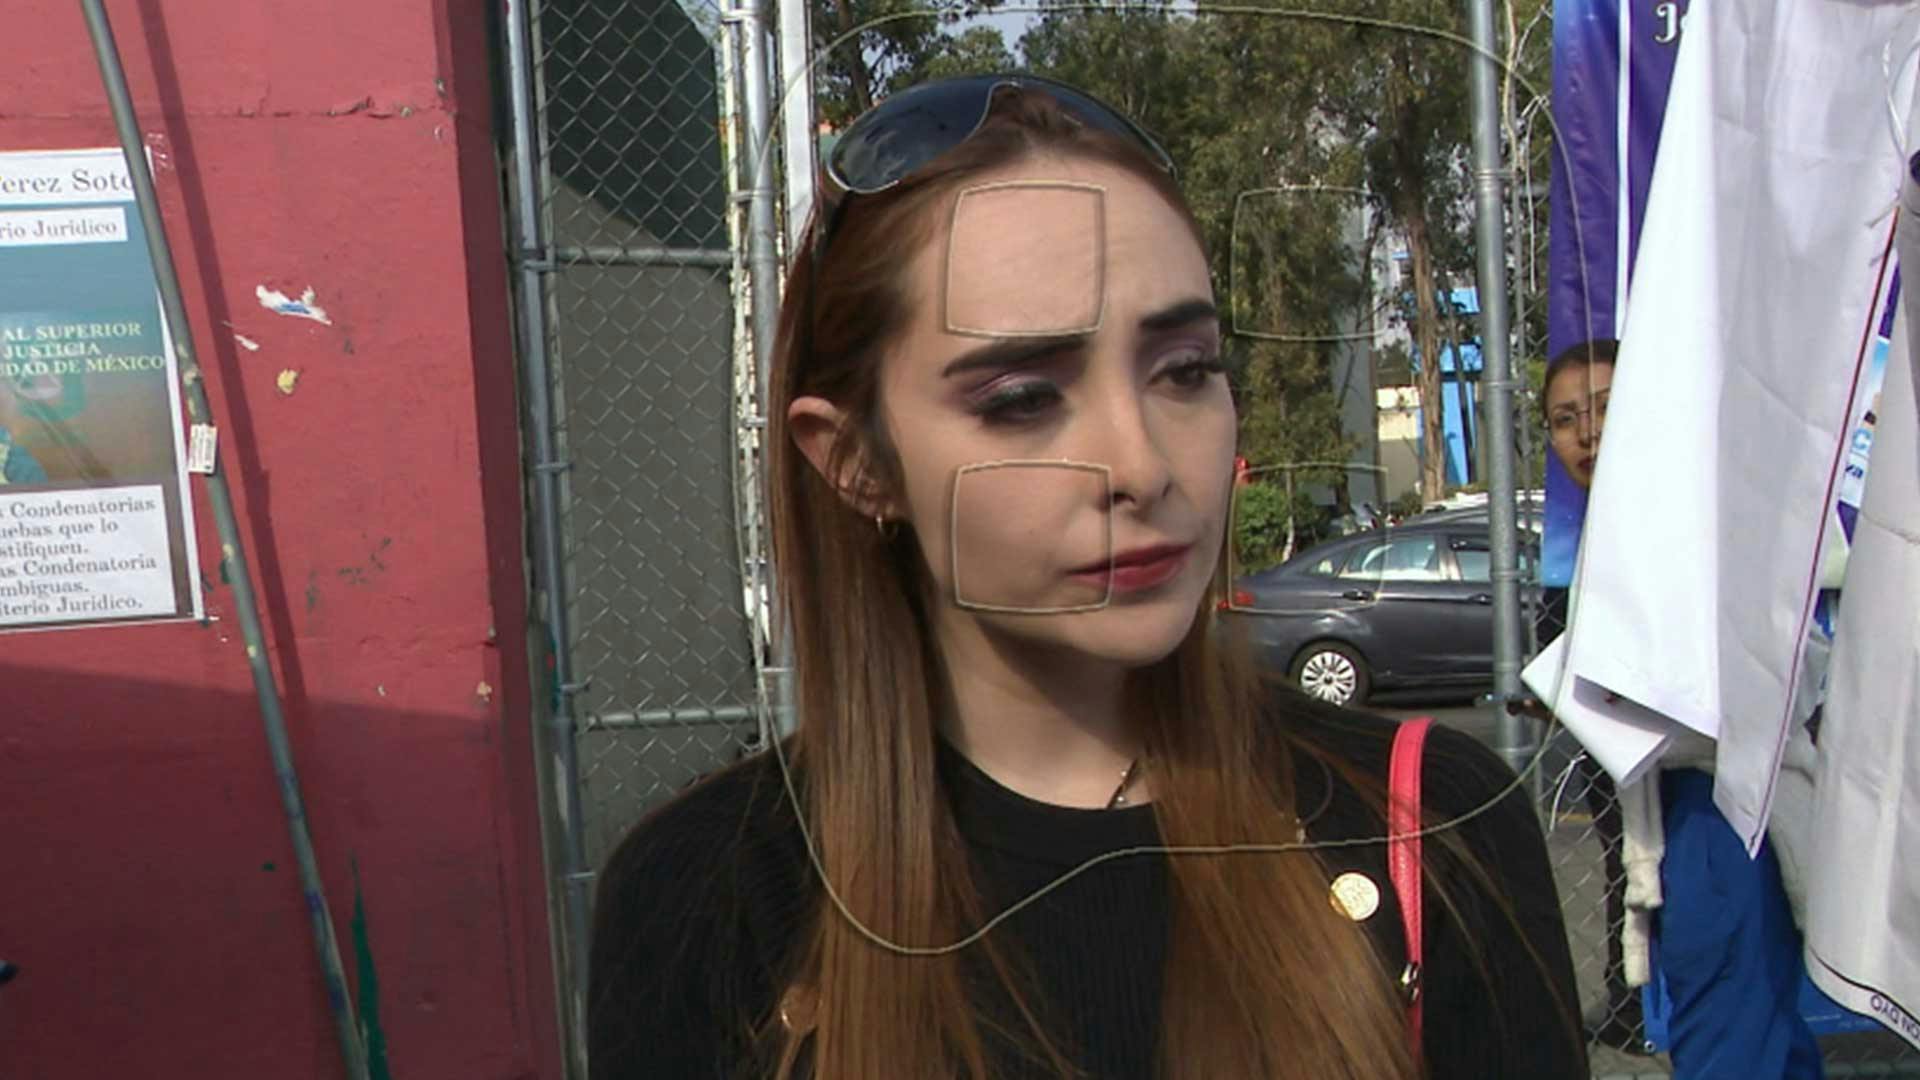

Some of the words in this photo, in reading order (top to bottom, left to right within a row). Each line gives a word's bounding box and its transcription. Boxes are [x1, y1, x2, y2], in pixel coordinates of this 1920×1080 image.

[0, 172, 62, 193] erez
[36, 322, 142, 340] SUPERIOR
[3, 342, 101, 359] JUSTICIA
[54, 359, 81, 374] DE
[85, 353, 165, 373] MÉXICO
[10, 497, 156, 518] Condenatorias
[59, 523, 94, 539] que
[101, 517, 118, 533] lo
[24, 553, 156, 577] Condenatoria
